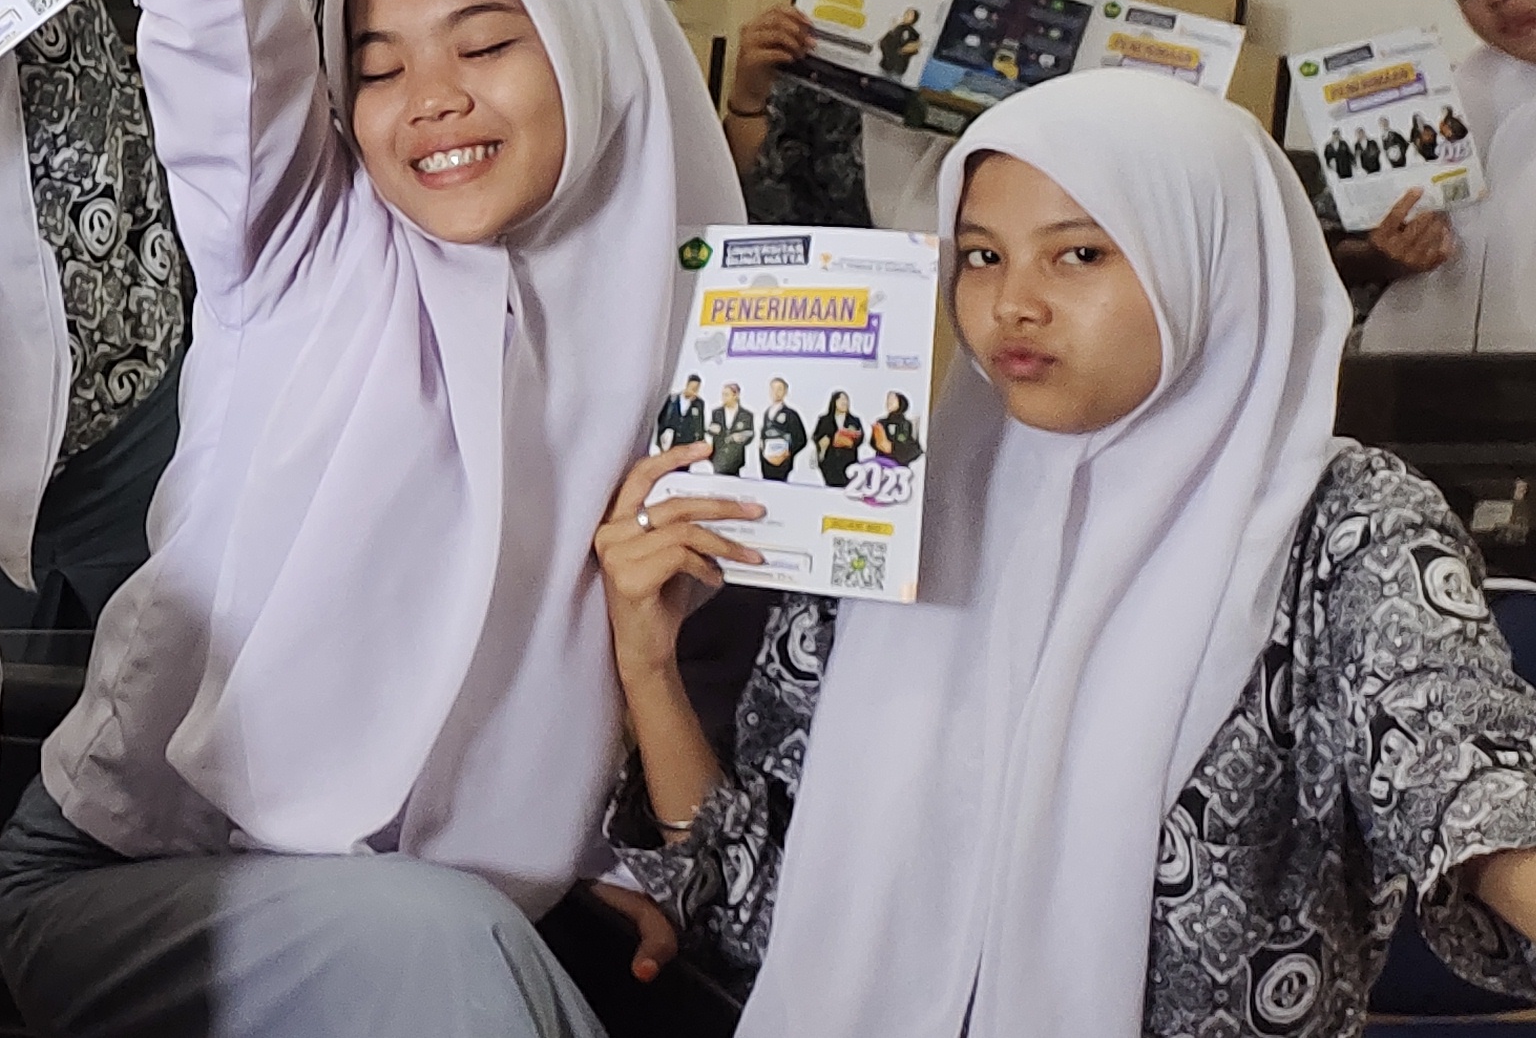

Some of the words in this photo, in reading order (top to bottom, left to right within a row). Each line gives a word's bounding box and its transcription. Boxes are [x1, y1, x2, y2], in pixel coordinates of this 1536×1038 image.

[711, 296, 856, 322] PENERIMAAN
[731, 330, 826, 353] MAHASISWA
[829, 332, 876, 355] BARU
[845, 461, 913, 503] 2023
